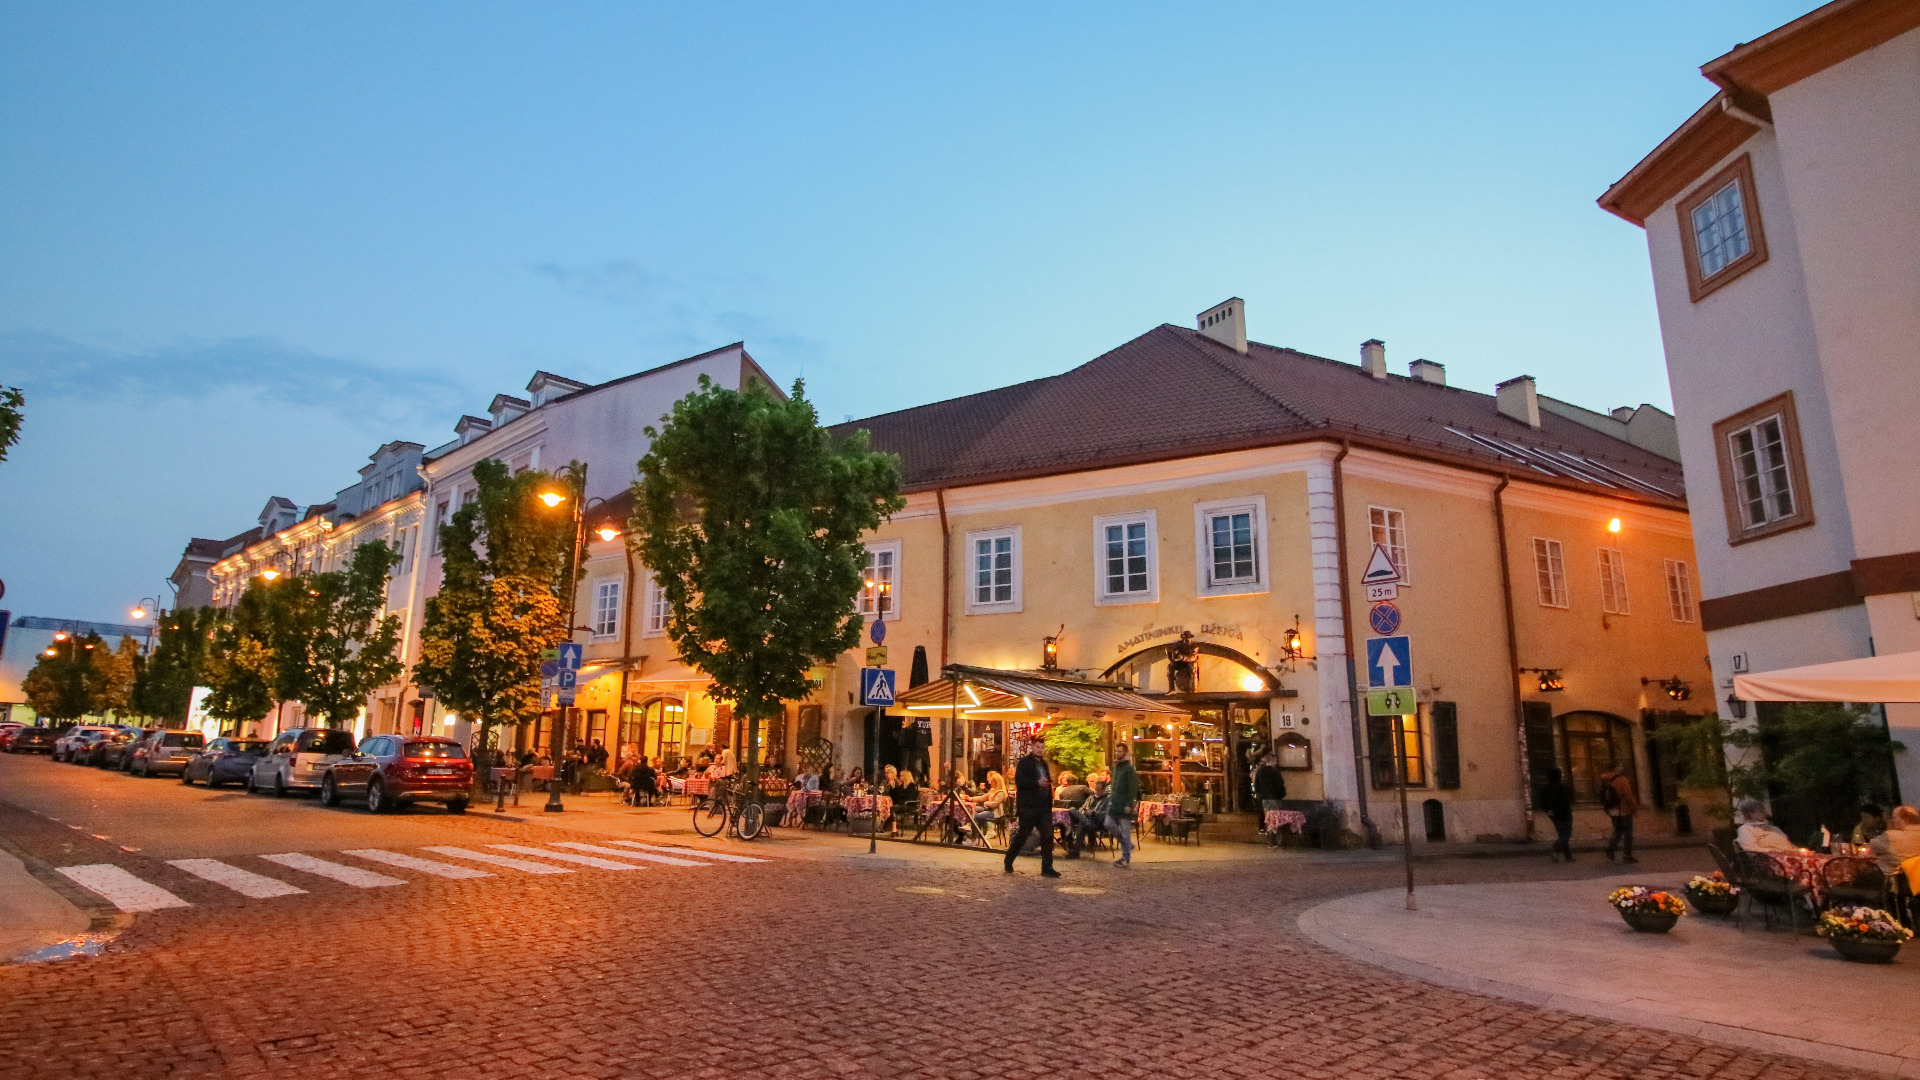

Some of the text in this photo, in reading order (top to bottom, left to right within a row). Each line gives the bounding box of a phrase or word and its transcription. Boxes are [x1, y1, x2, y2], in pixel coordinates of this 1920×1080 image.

[1371, 588, 1392, 597] 25 m
[1733, 655, 1741, 669] 17
[563, 672, 574, 686] P
[1282, 714, 1292, 727] 19
